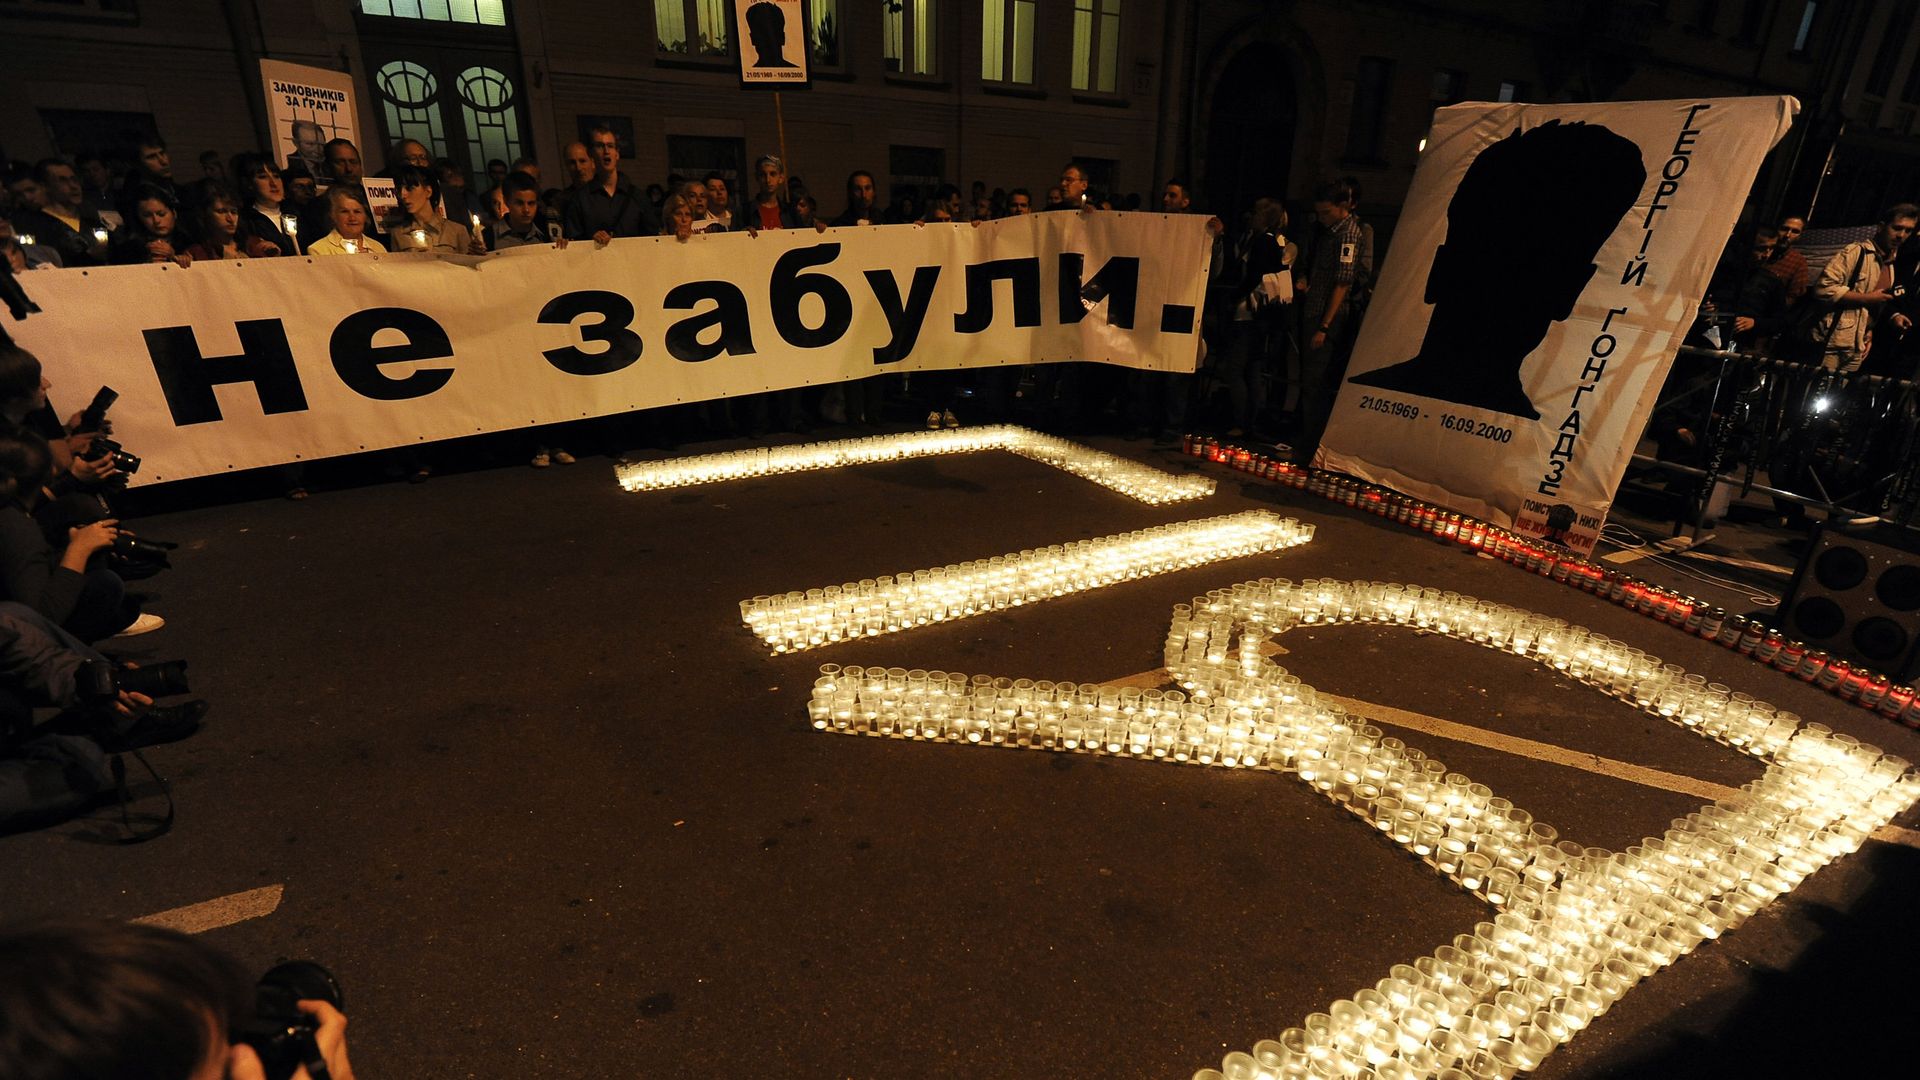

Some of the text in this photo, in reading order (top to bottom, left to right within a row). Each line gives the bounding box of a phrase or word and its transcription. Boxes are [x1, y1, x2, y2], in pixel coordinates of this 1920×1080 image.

[273, 82, 346, 102] ЗАМОВНИКІВ
[285, 96, 338, 112] ЗА ҐРАТИ
[368, 187, 397, 199] ПОМСТ
[141, 243, 1196, 427] не забули.
[1359, 395, 1419, 420] 21.05.1969
[1440, 413, 1513, 444] 16.09.2000
[1523, 499, 1552, 516] ПОМСТ
